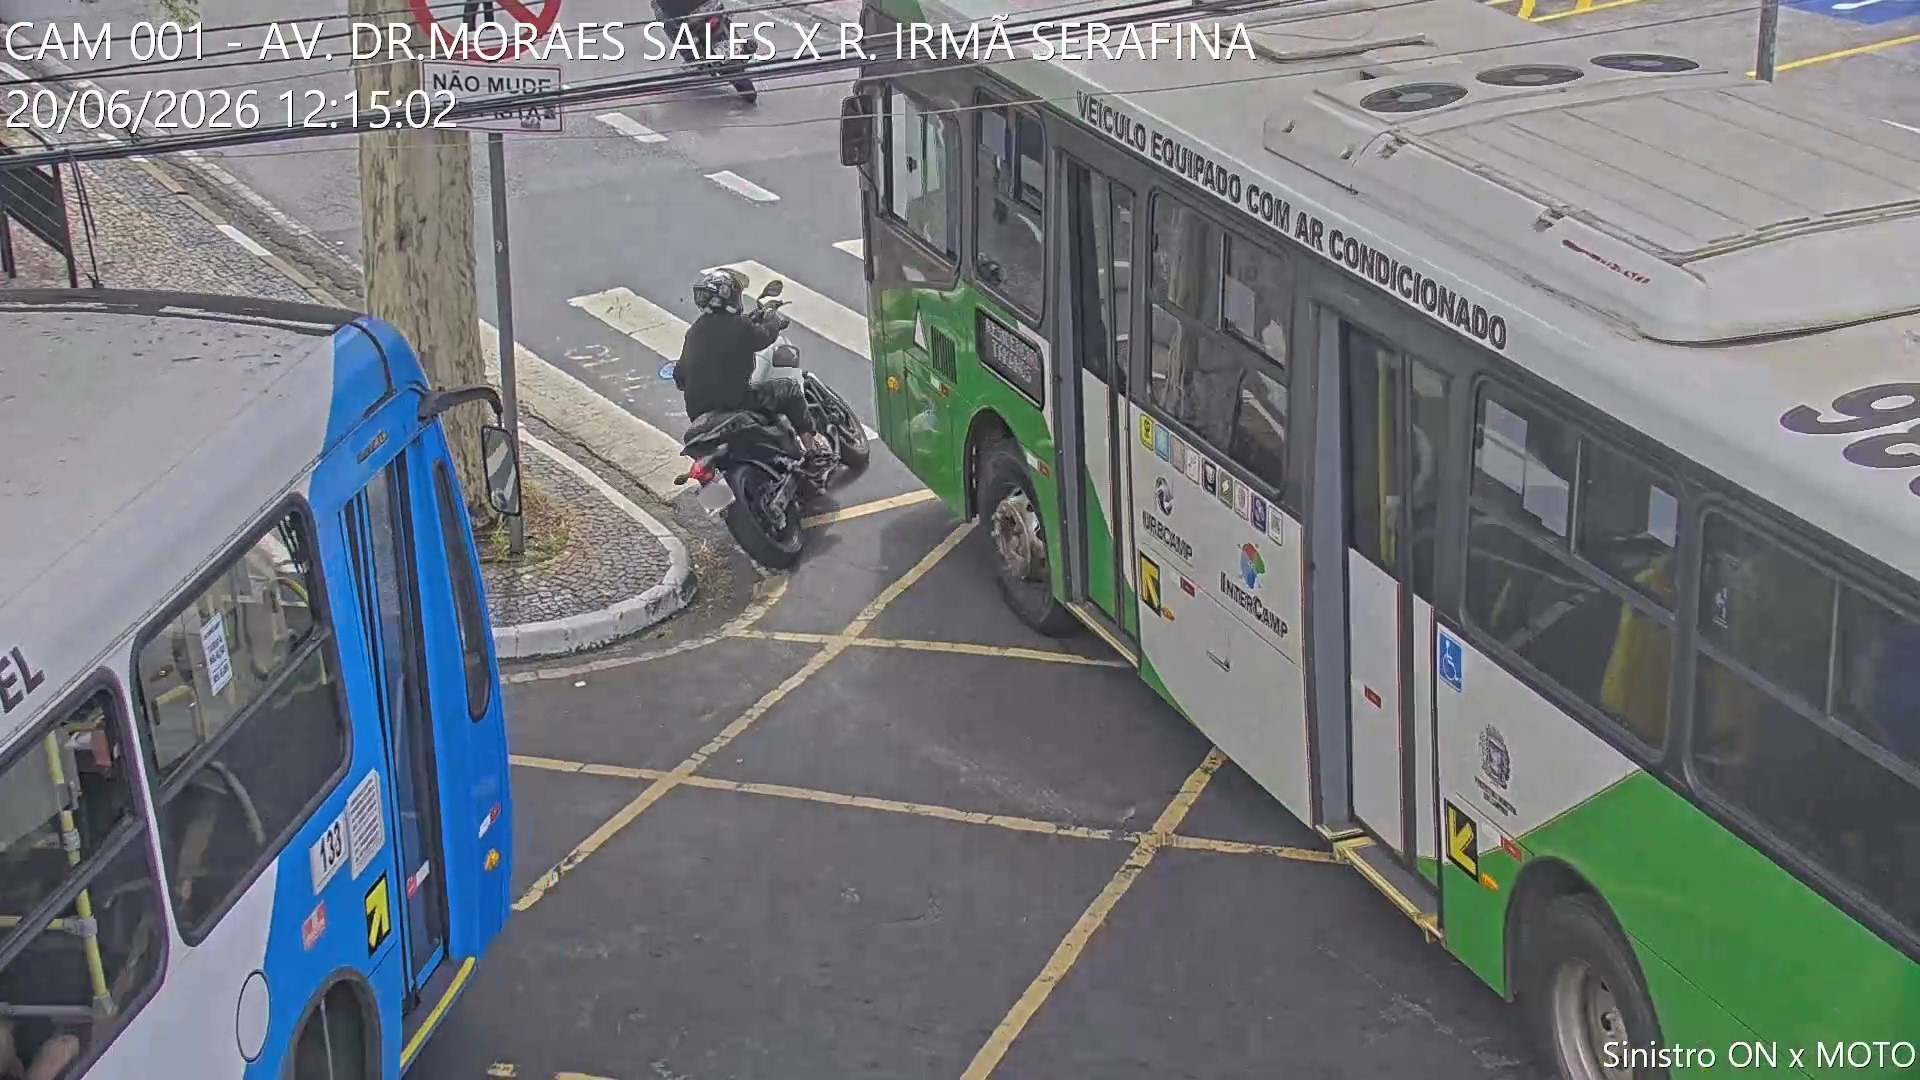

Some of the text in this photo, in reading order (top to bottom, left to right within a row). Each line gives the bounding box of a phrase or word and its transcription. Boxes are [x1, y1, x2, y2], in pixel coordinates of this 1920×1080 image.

[433, 70, 551, 95] NÃO MUDE
[1151, 130, 1242, 204] EQUIPADO
[1246, 183, 1291, 233] COM
[1293, 210, 1325, 252] AR
[1328, 228, 1508, 350] CONDICIONADO
[1142, 510, 1194, 561] URBCAMP
[320, 821, 343, 873] 133
